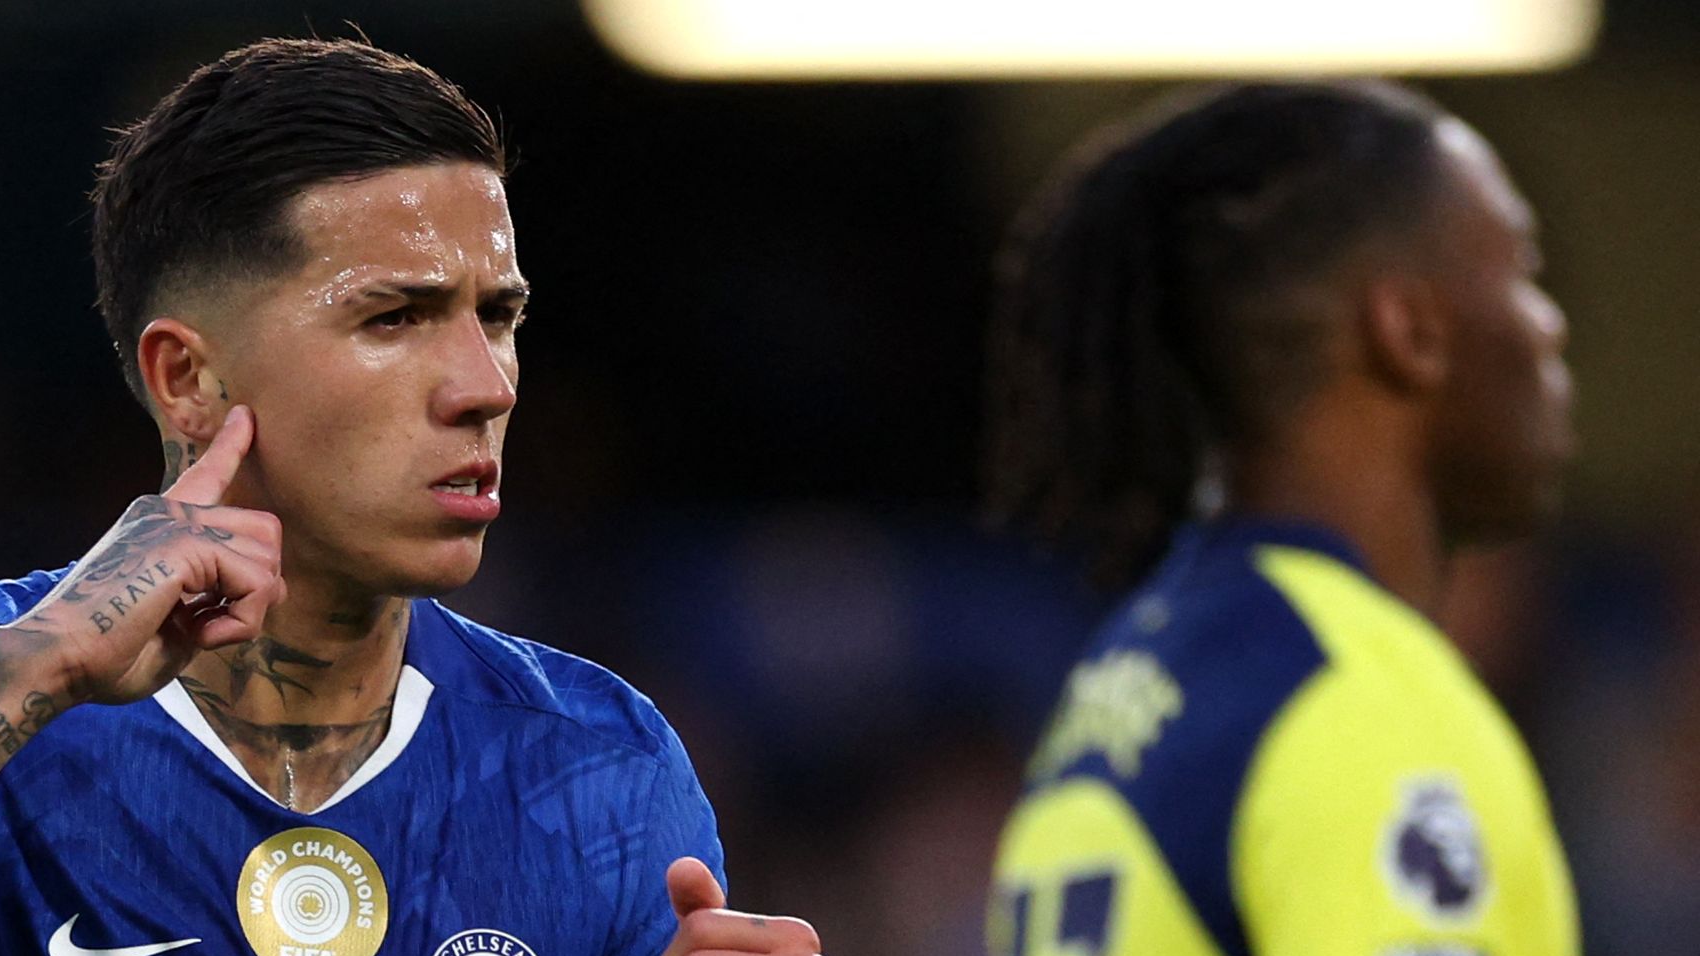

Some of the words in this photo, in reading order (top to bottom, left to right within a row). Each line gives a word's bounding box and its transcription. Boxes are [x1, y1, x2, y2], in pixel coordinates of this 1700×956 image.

[89, 559, 175, 635] BRAVE
[249, 849, 288, 916] WORLD
[291, 840, 374, 930] CHAMPIONS
